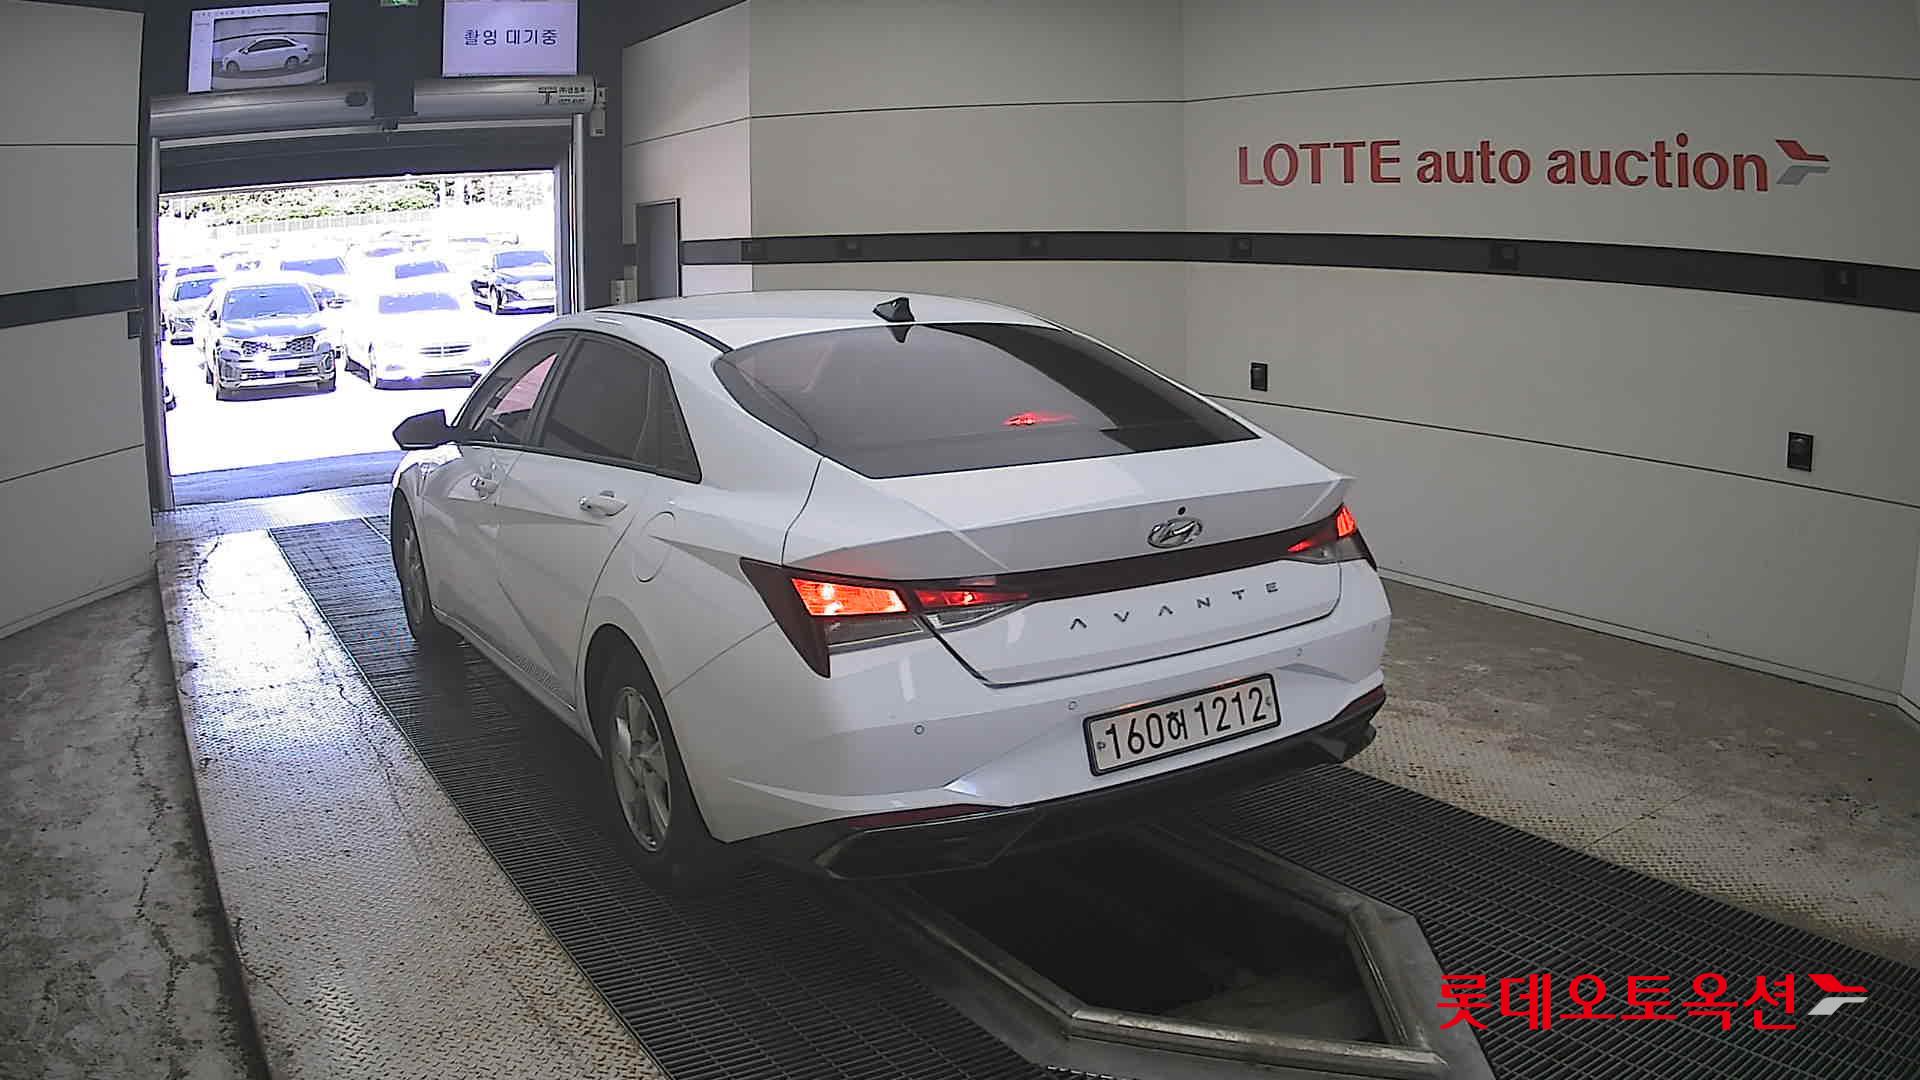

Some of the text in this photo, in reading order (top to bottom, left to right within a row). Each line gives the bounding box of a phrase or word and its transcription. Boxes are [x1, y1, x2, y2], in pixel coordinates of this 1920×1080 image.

[464, 29, 558, 46] 촬영 대기중
[1238, 132, 1770, 192] LOTTE auto auction
[1069, 581, 1280, 631] AVANTE
